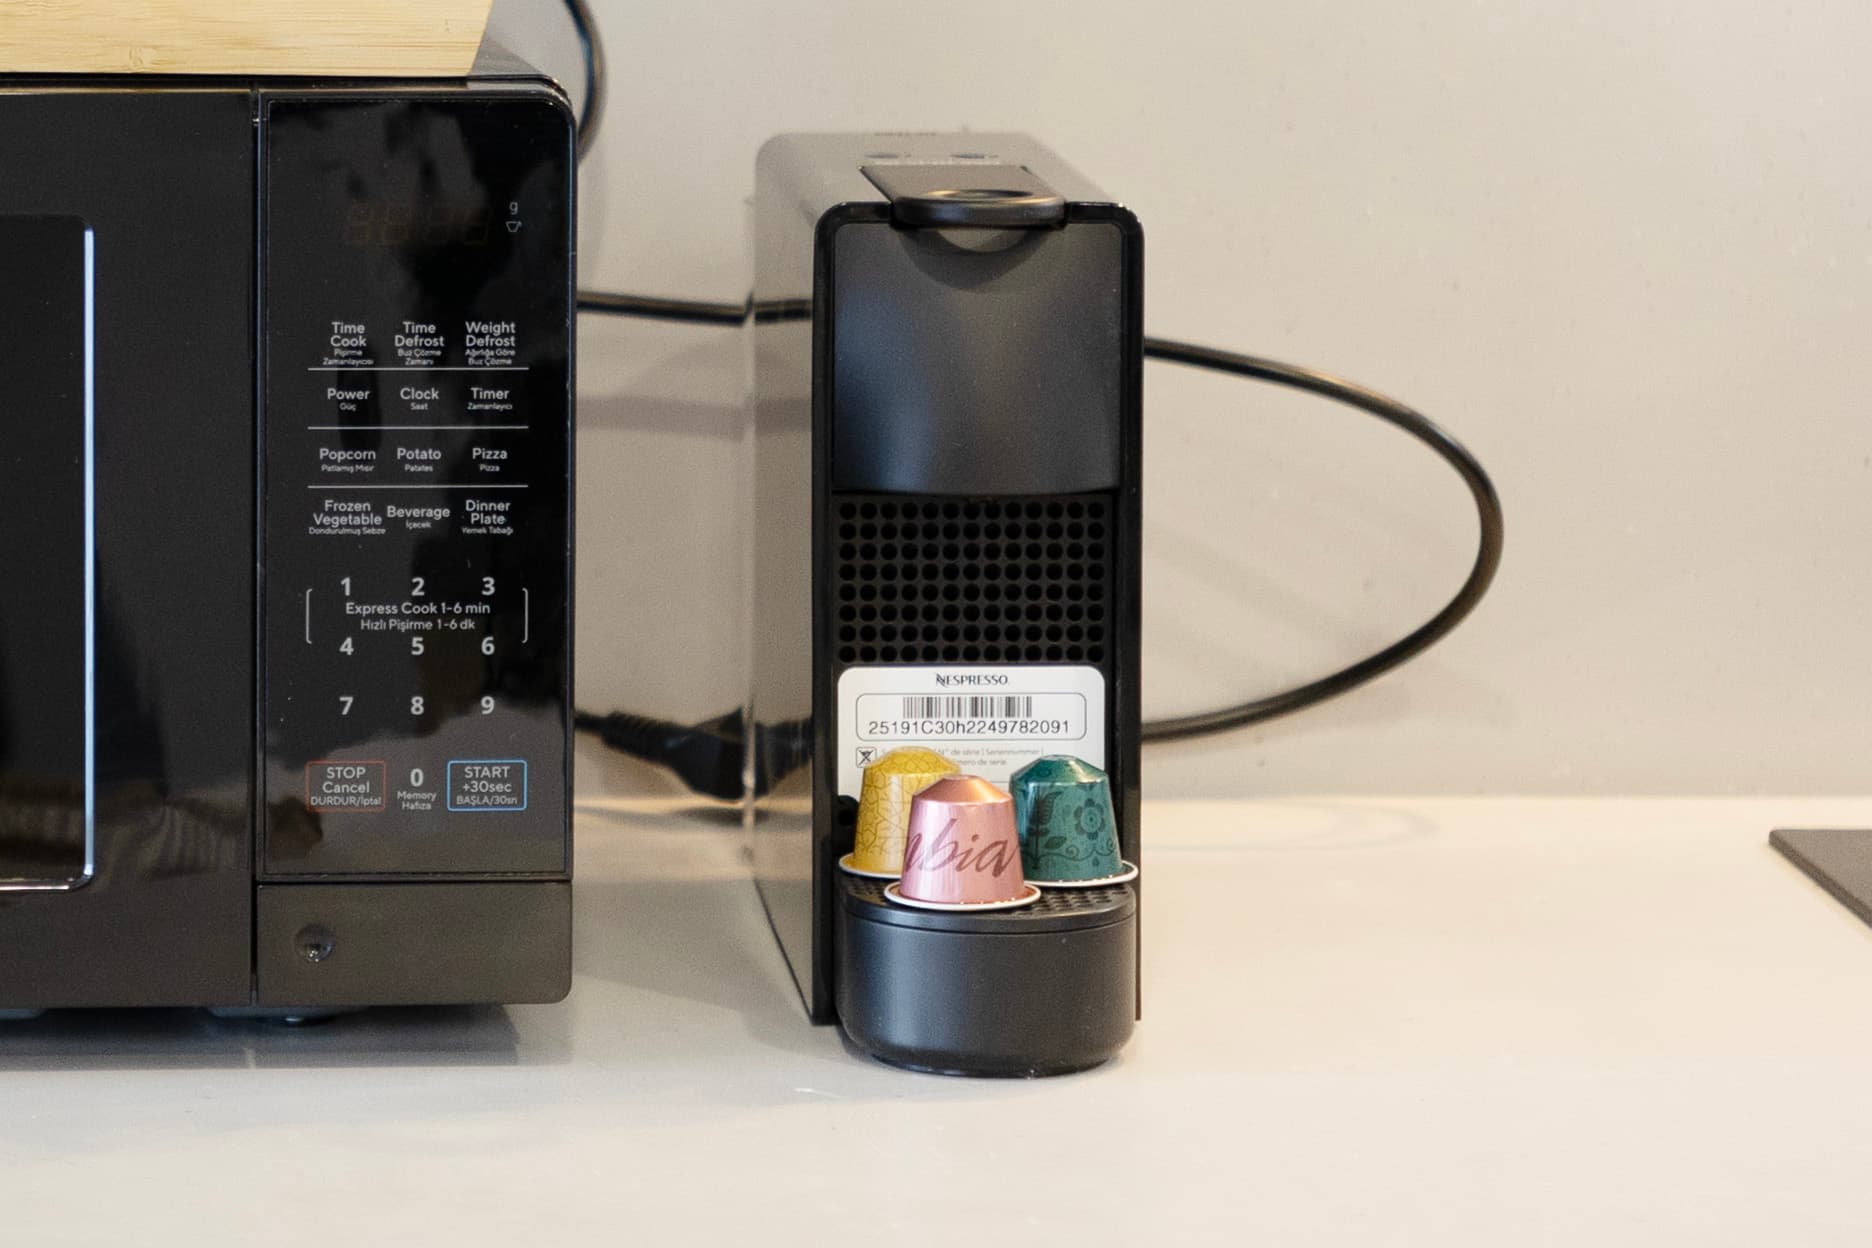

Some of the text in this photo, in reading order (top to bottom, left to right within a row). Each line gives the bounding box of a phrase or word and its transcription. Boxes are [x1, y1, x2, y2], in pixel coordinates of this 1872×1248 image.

[332, 321, 365, 334] Time
[403, 321, 436, 334] Time
[465, 321, 516, 337] Weight
[330, 335, 367, 347] Cook
[394, 335, 444, 347] Defrost
[466, 335, 516, 347] Defrost
[327, 388, 370, 401] Power
[400, 387, 439, 400] Clock
[471, 387, 509, 400] Timer
[319, 448, 376, 463] Popcorn
[397, 447, 442, 460] Potato
[472, 447, 508, 460] Pizza
[479, 463, 500, 472] Pizza
[324, 499, 371, 512] Frozen
[465, 499, 511, 512] Dinner
[386, 505, 451, 521] Beverage
[471, 512, 506, 525] Plate
[313, 513, 382, 528] Vegetable
[340, 576, 351, 596] 1
[411, 577, 425, 596] 2
[481, 576, 496, 596] 3
[346, 602, 491, 616] Express Cook 1-6 min
[389, 618, 433, 633] Pişirme
[437, 618, 458, 630] 1-6
[460, 618, 475, 630] dk
[339, 637, 354, 656] 4
[411, 637, 425, 655] 5
[481, 636, 495, 655] 6
[936, 673, 1008, 688] NESPRESSO
[339, 696, 354, 715] 7
[410, 696, 424, 715] 8
[481, 696, 495, 714] 9
[869, 720, 1069, 735] 25191C30h2249782091
[326, 766, 366, 779] STOP
[410, 768, 424, 787] 0
[464, 766, 510, 778] START
[322, 781, 370, 794] Cancel
[462, 780, 512, 793] +30sec
[396, 790, 437, 801] Memory
